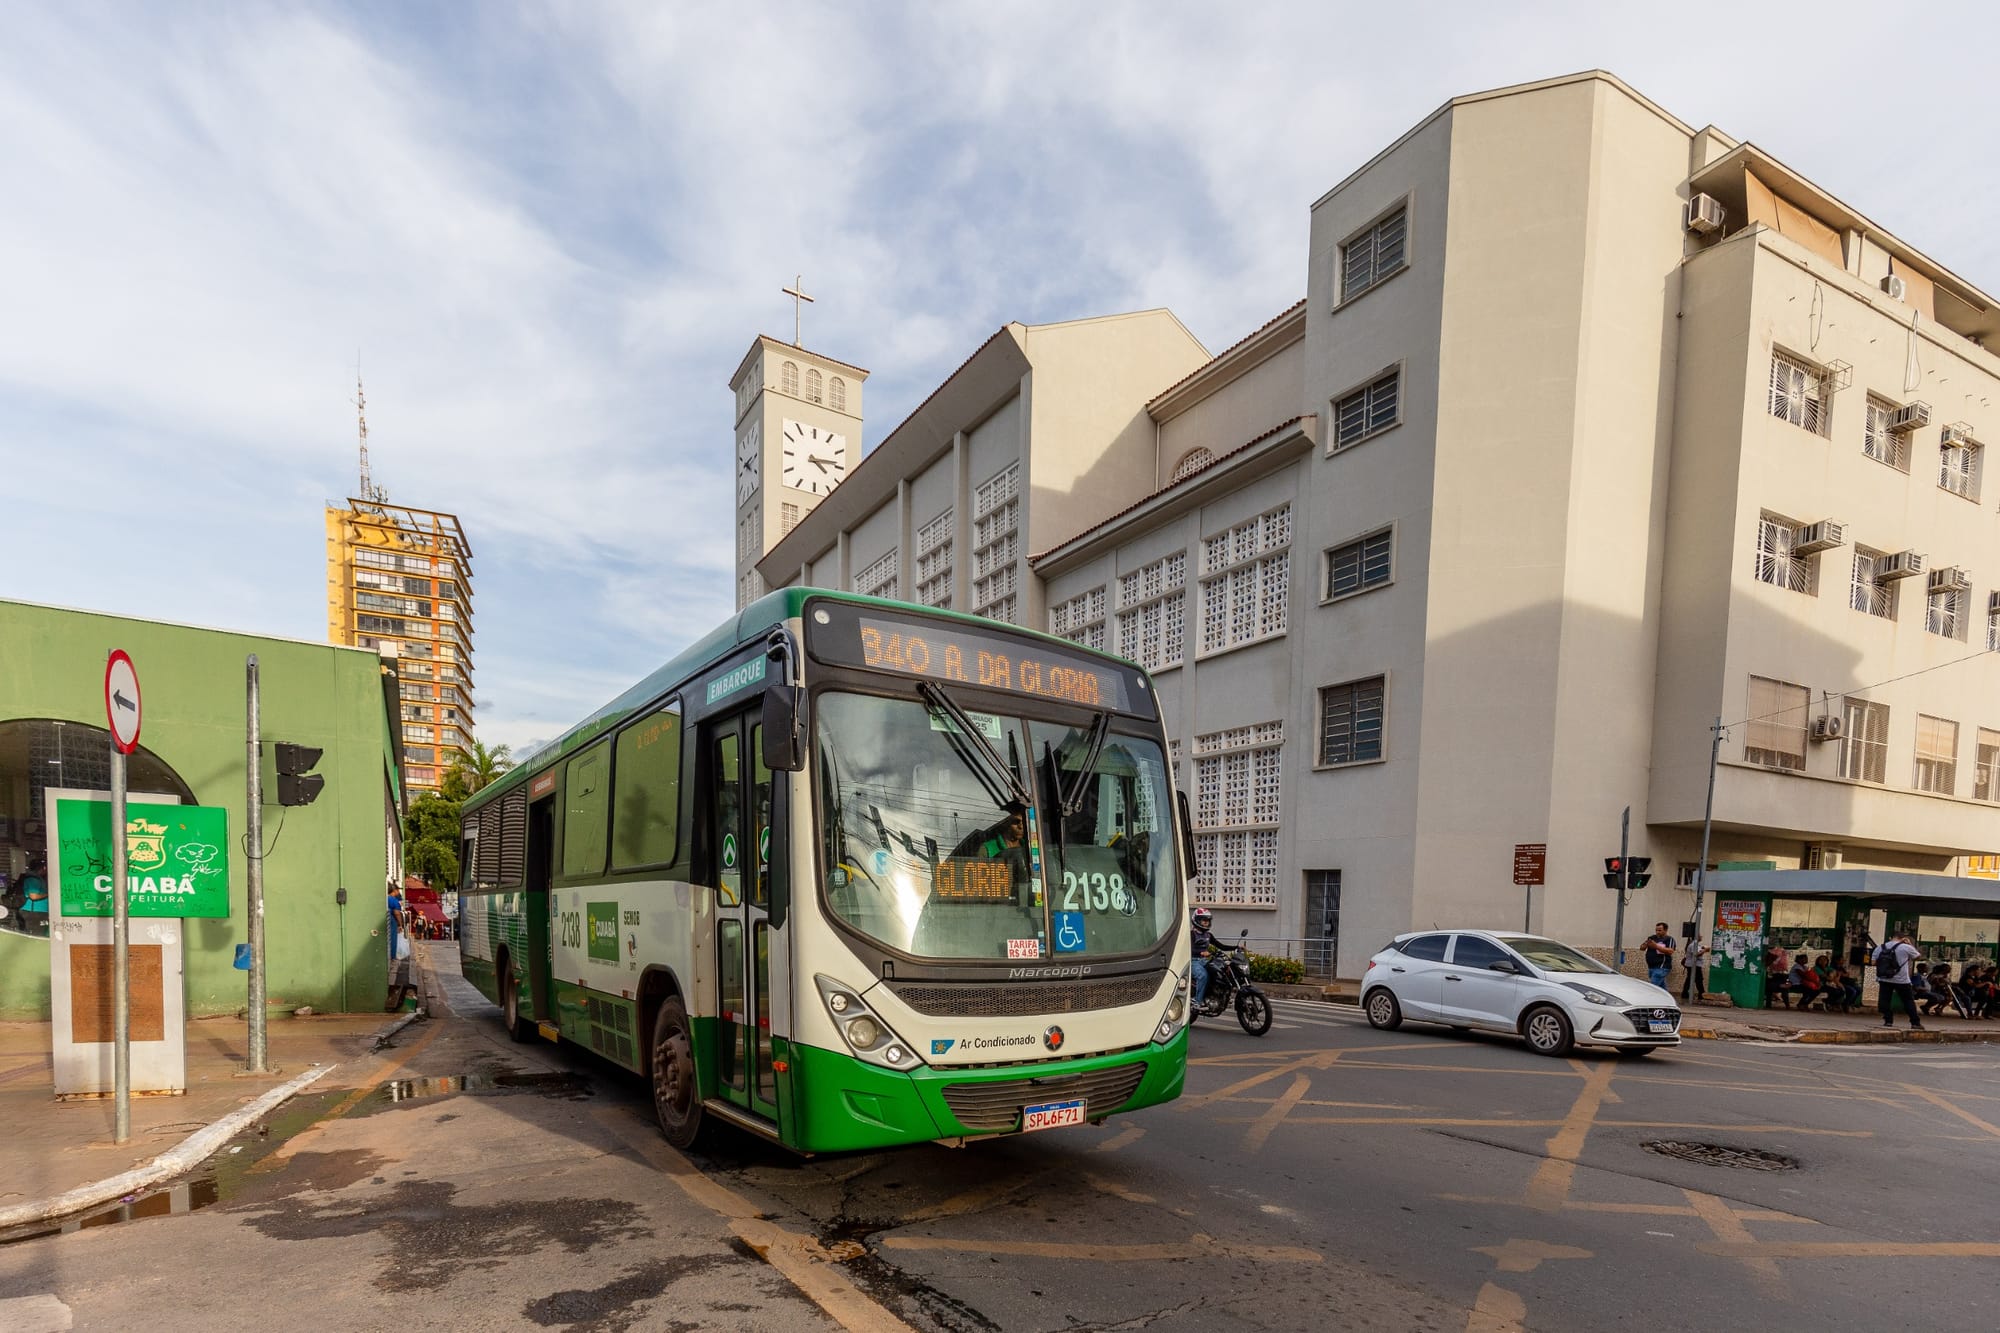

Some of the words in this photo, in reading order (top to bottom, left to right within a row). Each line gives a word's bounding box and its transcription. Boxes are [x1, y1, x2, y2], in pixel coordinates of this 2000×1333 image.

[861, 626, 930, 673] 340
[945, 645, 968, 682] A.
[978, 650, 1010, 689] DA
[1020, 659, 1100, 705] GLORIA
[710, 660, 761, 699] EMBARQUE
[935, 861, 1009, 897] GLORIA
[105, 894, 185, 903] PFEITURA
[1063, 871, 1125, 911] 2138
[561, 912, 581, 949] 2138
[1008, 939, 1037, 949] TARIFA
[1022, 949, 1038, 957] 4.95
[1009, 965, 1091, 979] Marcopolo
[960, 1039, 972, 1049] Ar
[974, 1034, 1036, 1048] Condicionado
[1029, 1108, 1078, 1128] SPL6F71
